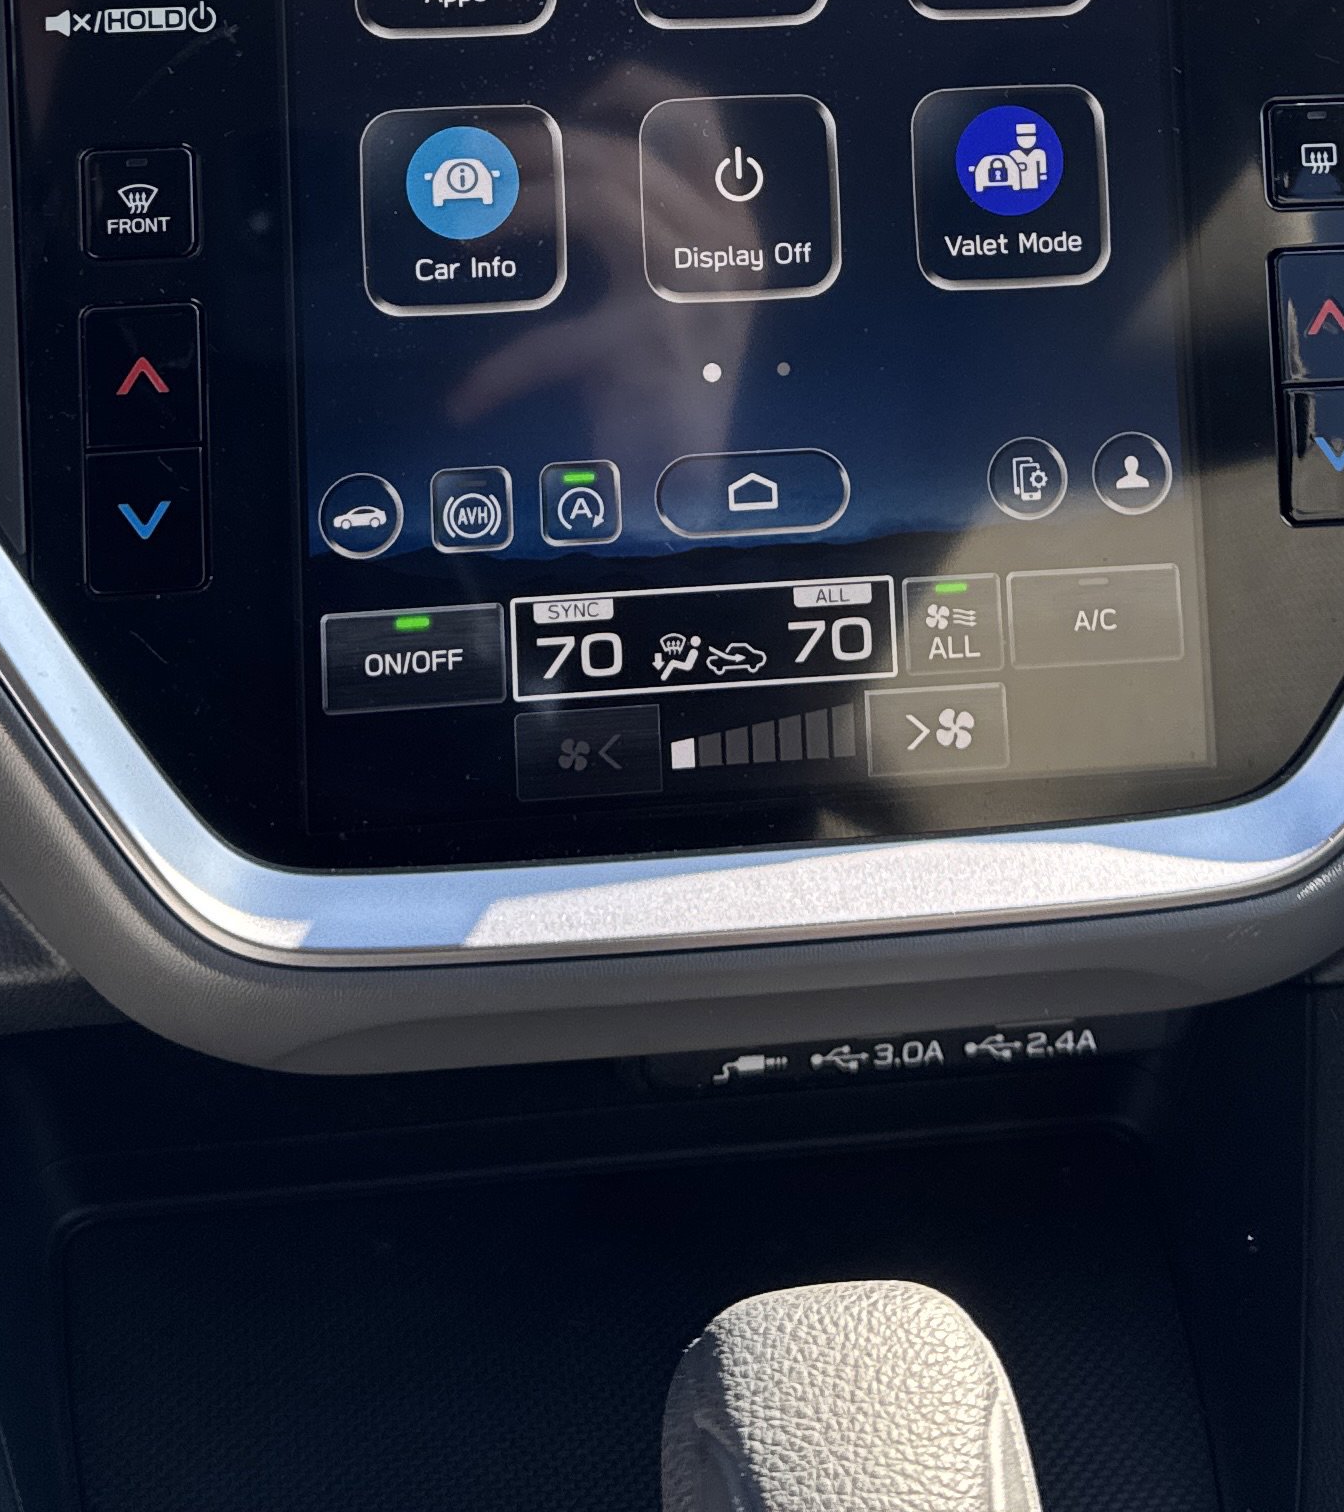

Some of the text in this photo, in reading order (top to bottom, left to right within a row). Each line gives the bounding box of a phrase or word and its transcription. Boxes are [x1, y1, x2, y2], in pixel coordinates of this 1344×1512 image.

[107, 216, 171, 235] FRONT
[674, 241, 812, 273] Display Off
[944, 230, 1083, 257] Valet Mode
[415, 255, 517, 282] Car Info
[457, 505, 489, 526] AVH
[816, 587, 851, 603] ALL
[547, 601, 600, 620] SYNC
[1074, 608, 1118, 632] A/C
[787, 616, 873, 663] 70
[928, 634, 981, 660] ALL
[364, 648, 464, 677] ON/OFF
[536, 632, 623, 680] 70
[873, 1029, 1097, 1066] 3.0A 2.4A
